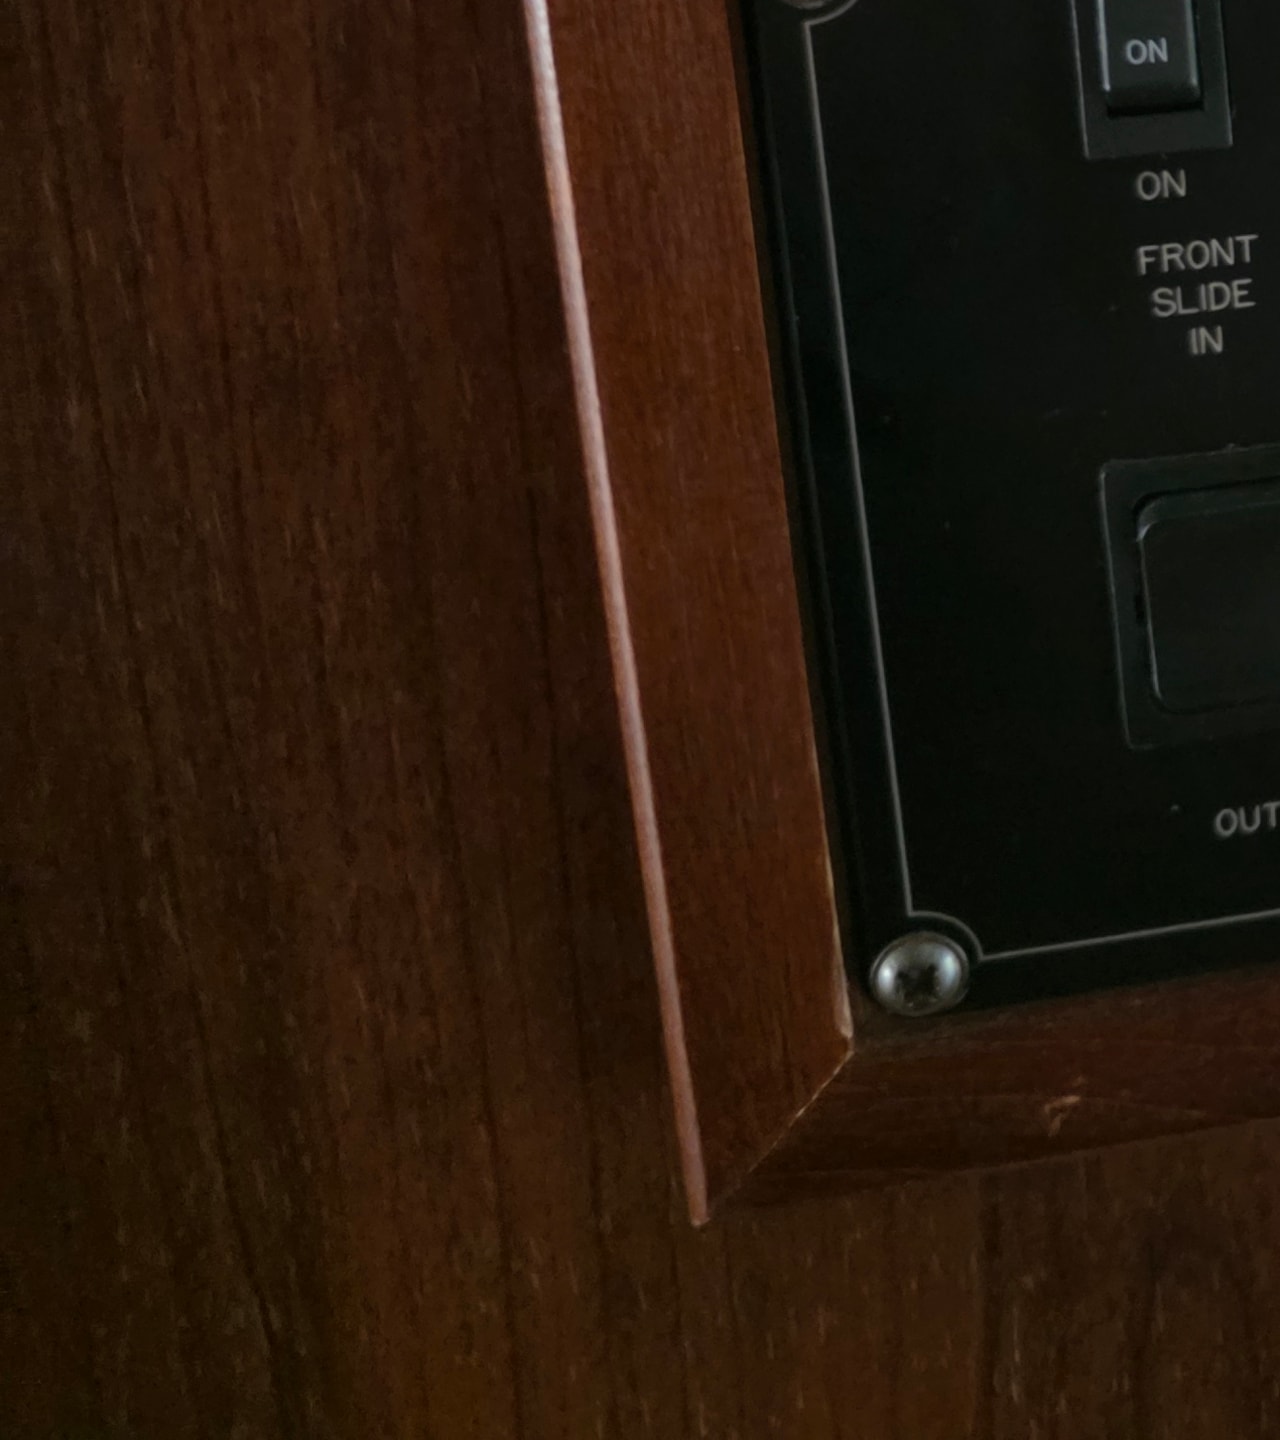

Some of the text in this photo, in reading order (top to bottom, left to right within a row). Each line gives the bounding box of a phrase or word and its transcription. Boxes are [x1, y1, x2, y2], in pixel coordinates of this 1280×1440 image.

[1124, 37, 1169, 65] ON
[1135, 169, 1188, 201] ON
[1135, 234, 1260, 276] FRONT
[1150, 278, 1257, 317] SLIDE
[1188, 325, 1225, 355] IN
